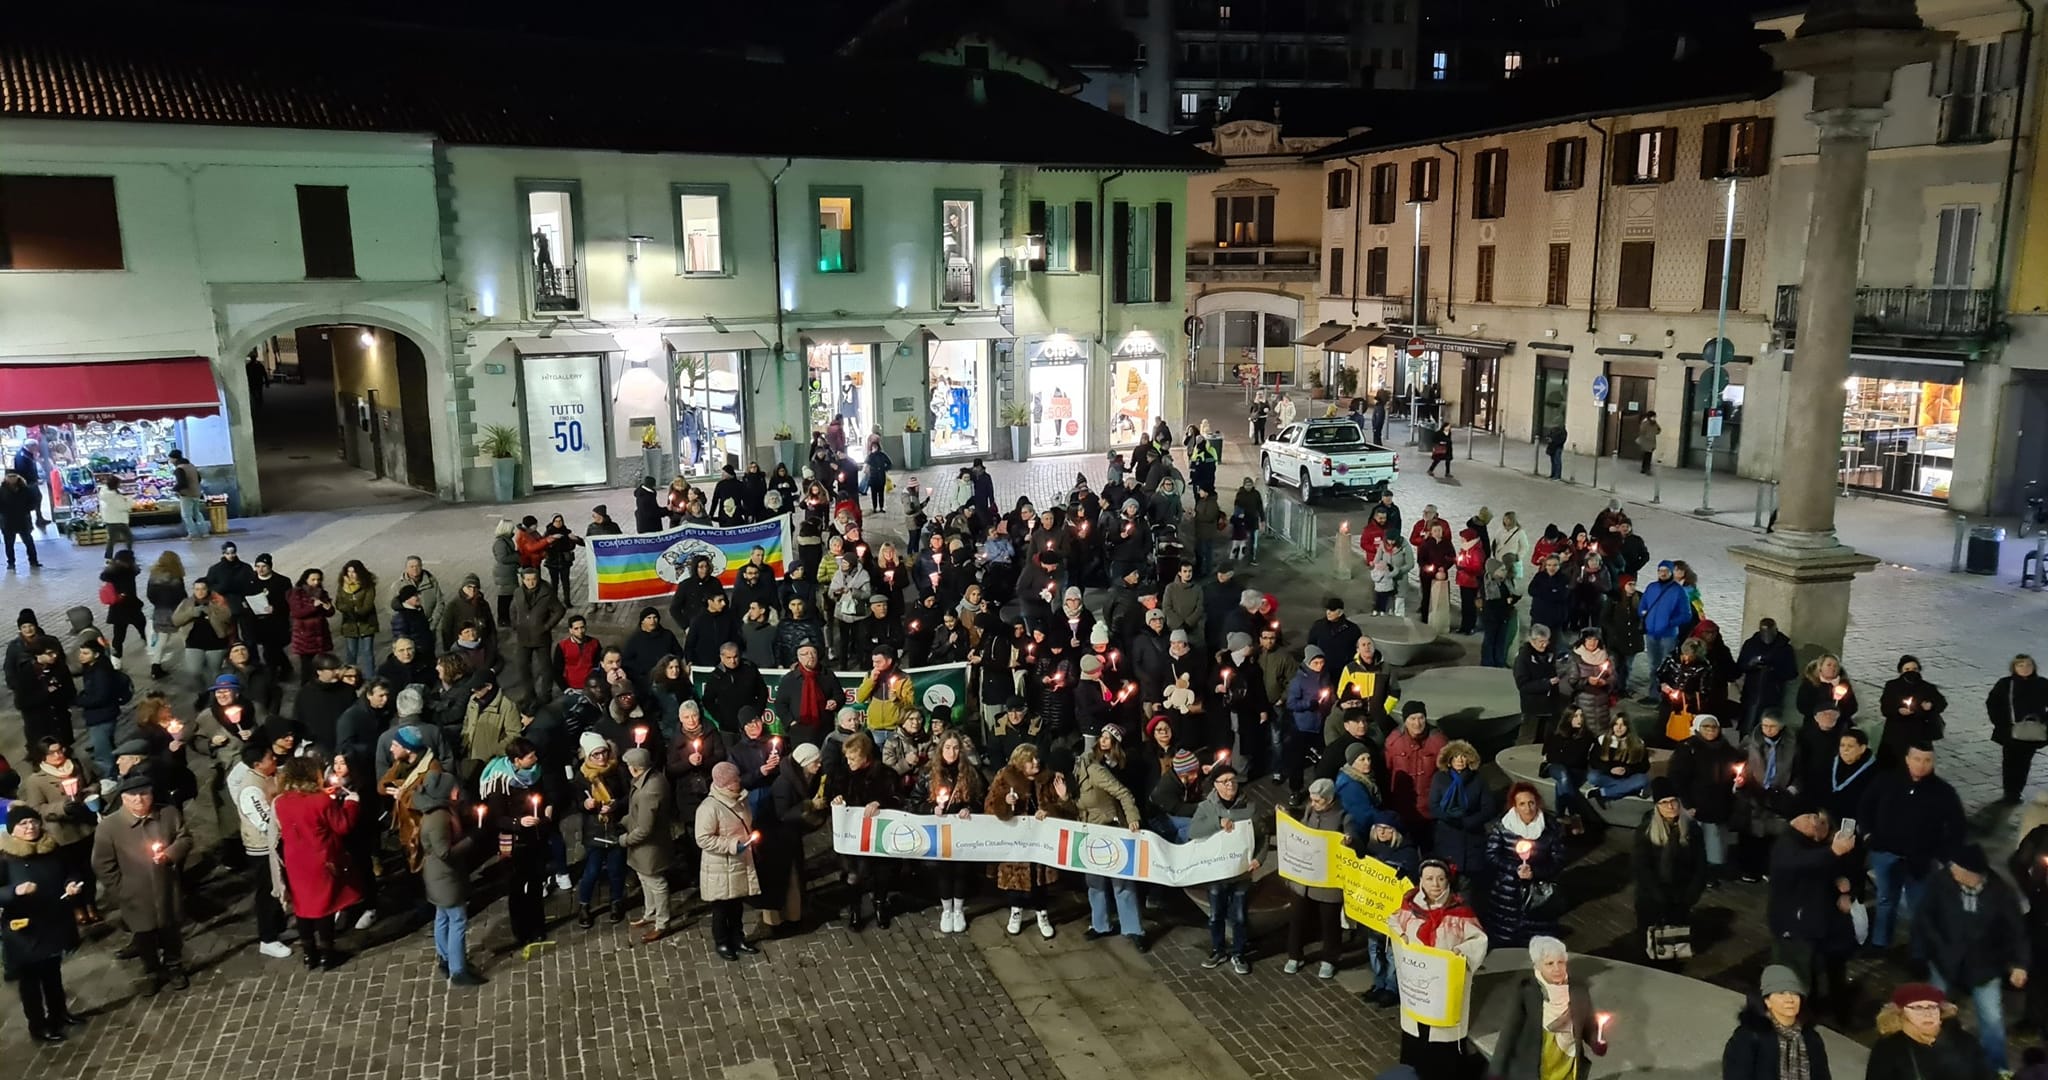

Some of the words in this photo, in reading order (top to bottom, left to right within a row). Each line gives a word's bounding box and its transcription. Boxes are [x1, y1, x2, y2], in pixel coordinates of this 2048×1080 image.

[1442, 344, 1479, 353] CONTINENTAL
[549, 403, 584, 416] TUTTO
[725, 528, 737, 536] DEL
